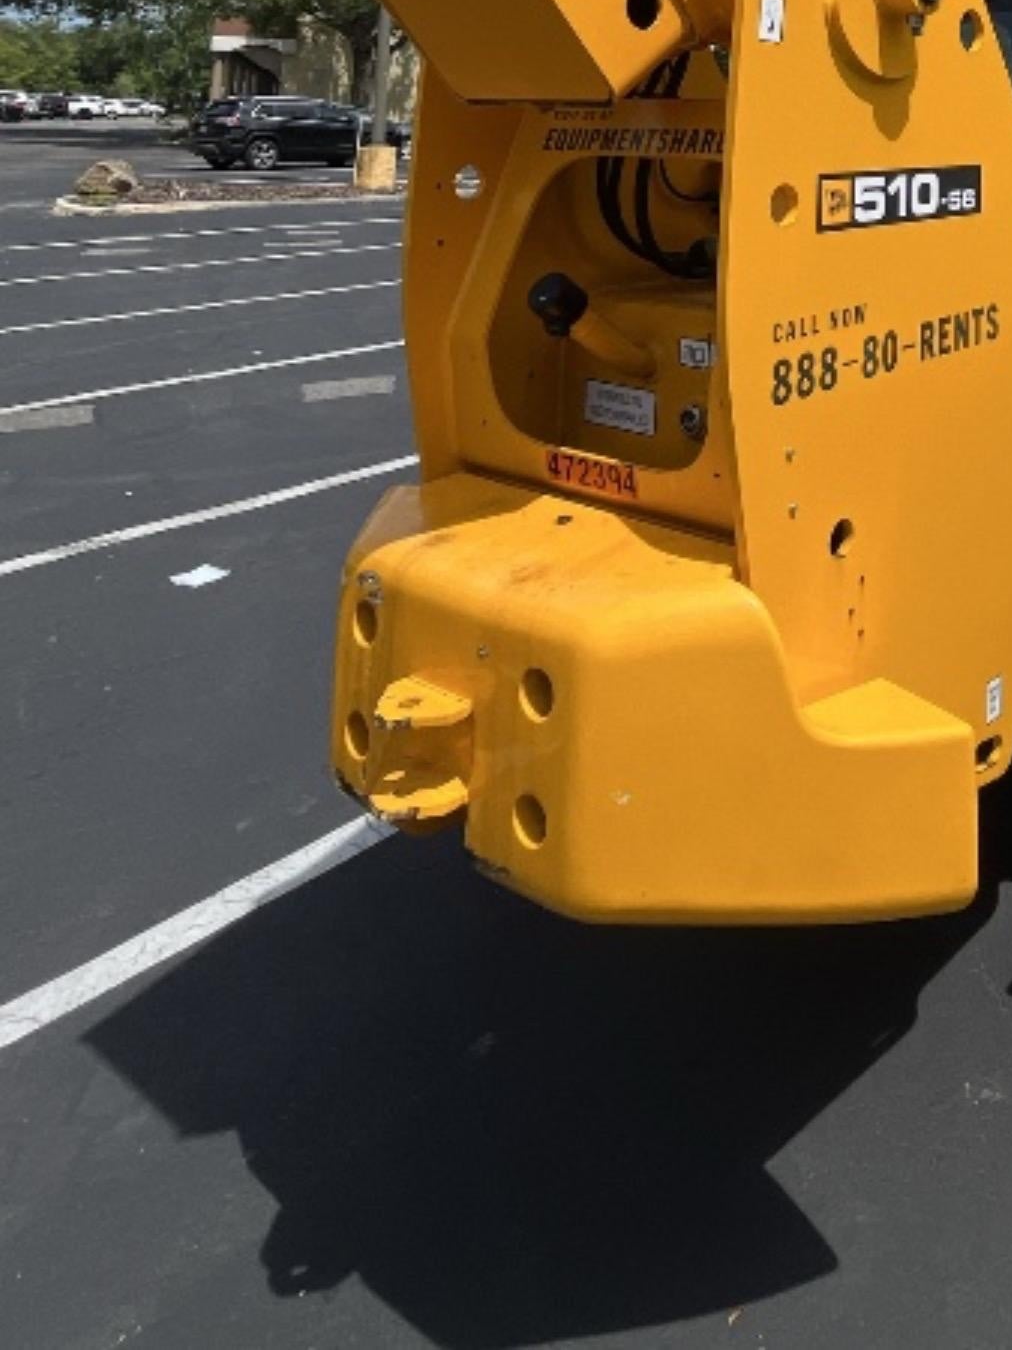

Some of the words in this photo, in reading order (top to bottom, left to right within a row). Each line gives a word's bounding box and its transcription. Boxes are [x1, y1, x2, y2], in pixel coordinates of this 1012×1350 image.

[772, 313, 820, 344] CALL
[771, 302, 1000, 406] 888-80-RENTS
[547, 451, 638, 497] 472394
